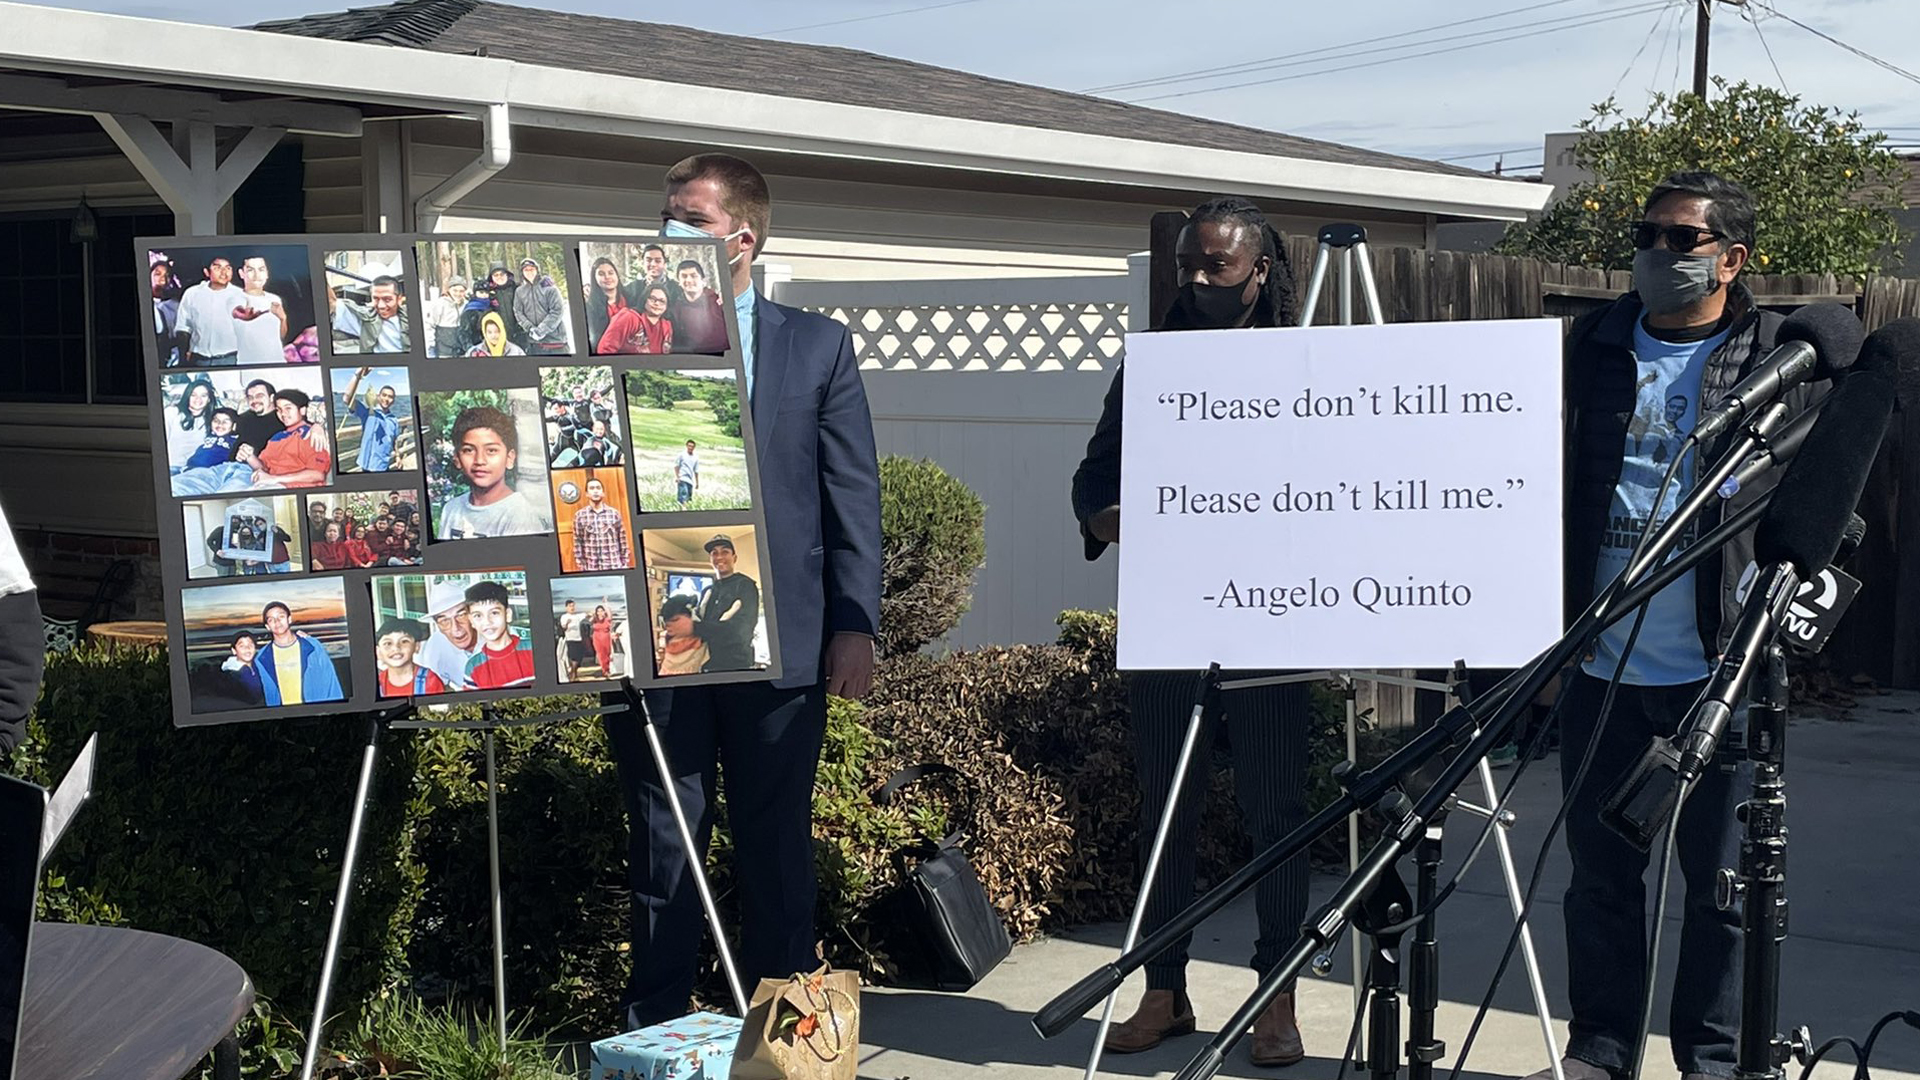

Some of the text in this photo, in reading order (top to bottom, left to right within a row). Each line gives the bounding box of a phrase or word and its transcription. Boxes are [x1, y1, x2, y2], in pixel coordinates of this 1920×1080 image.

[1158, 384, 1523, 421] “Please don’t kill me.
[1156, 478, 1525, 515] Please don’t kill me.”
[1203, 576, 1473, 617] -Angelo Quinto
[1780, 611, 1818, 641] TVU
